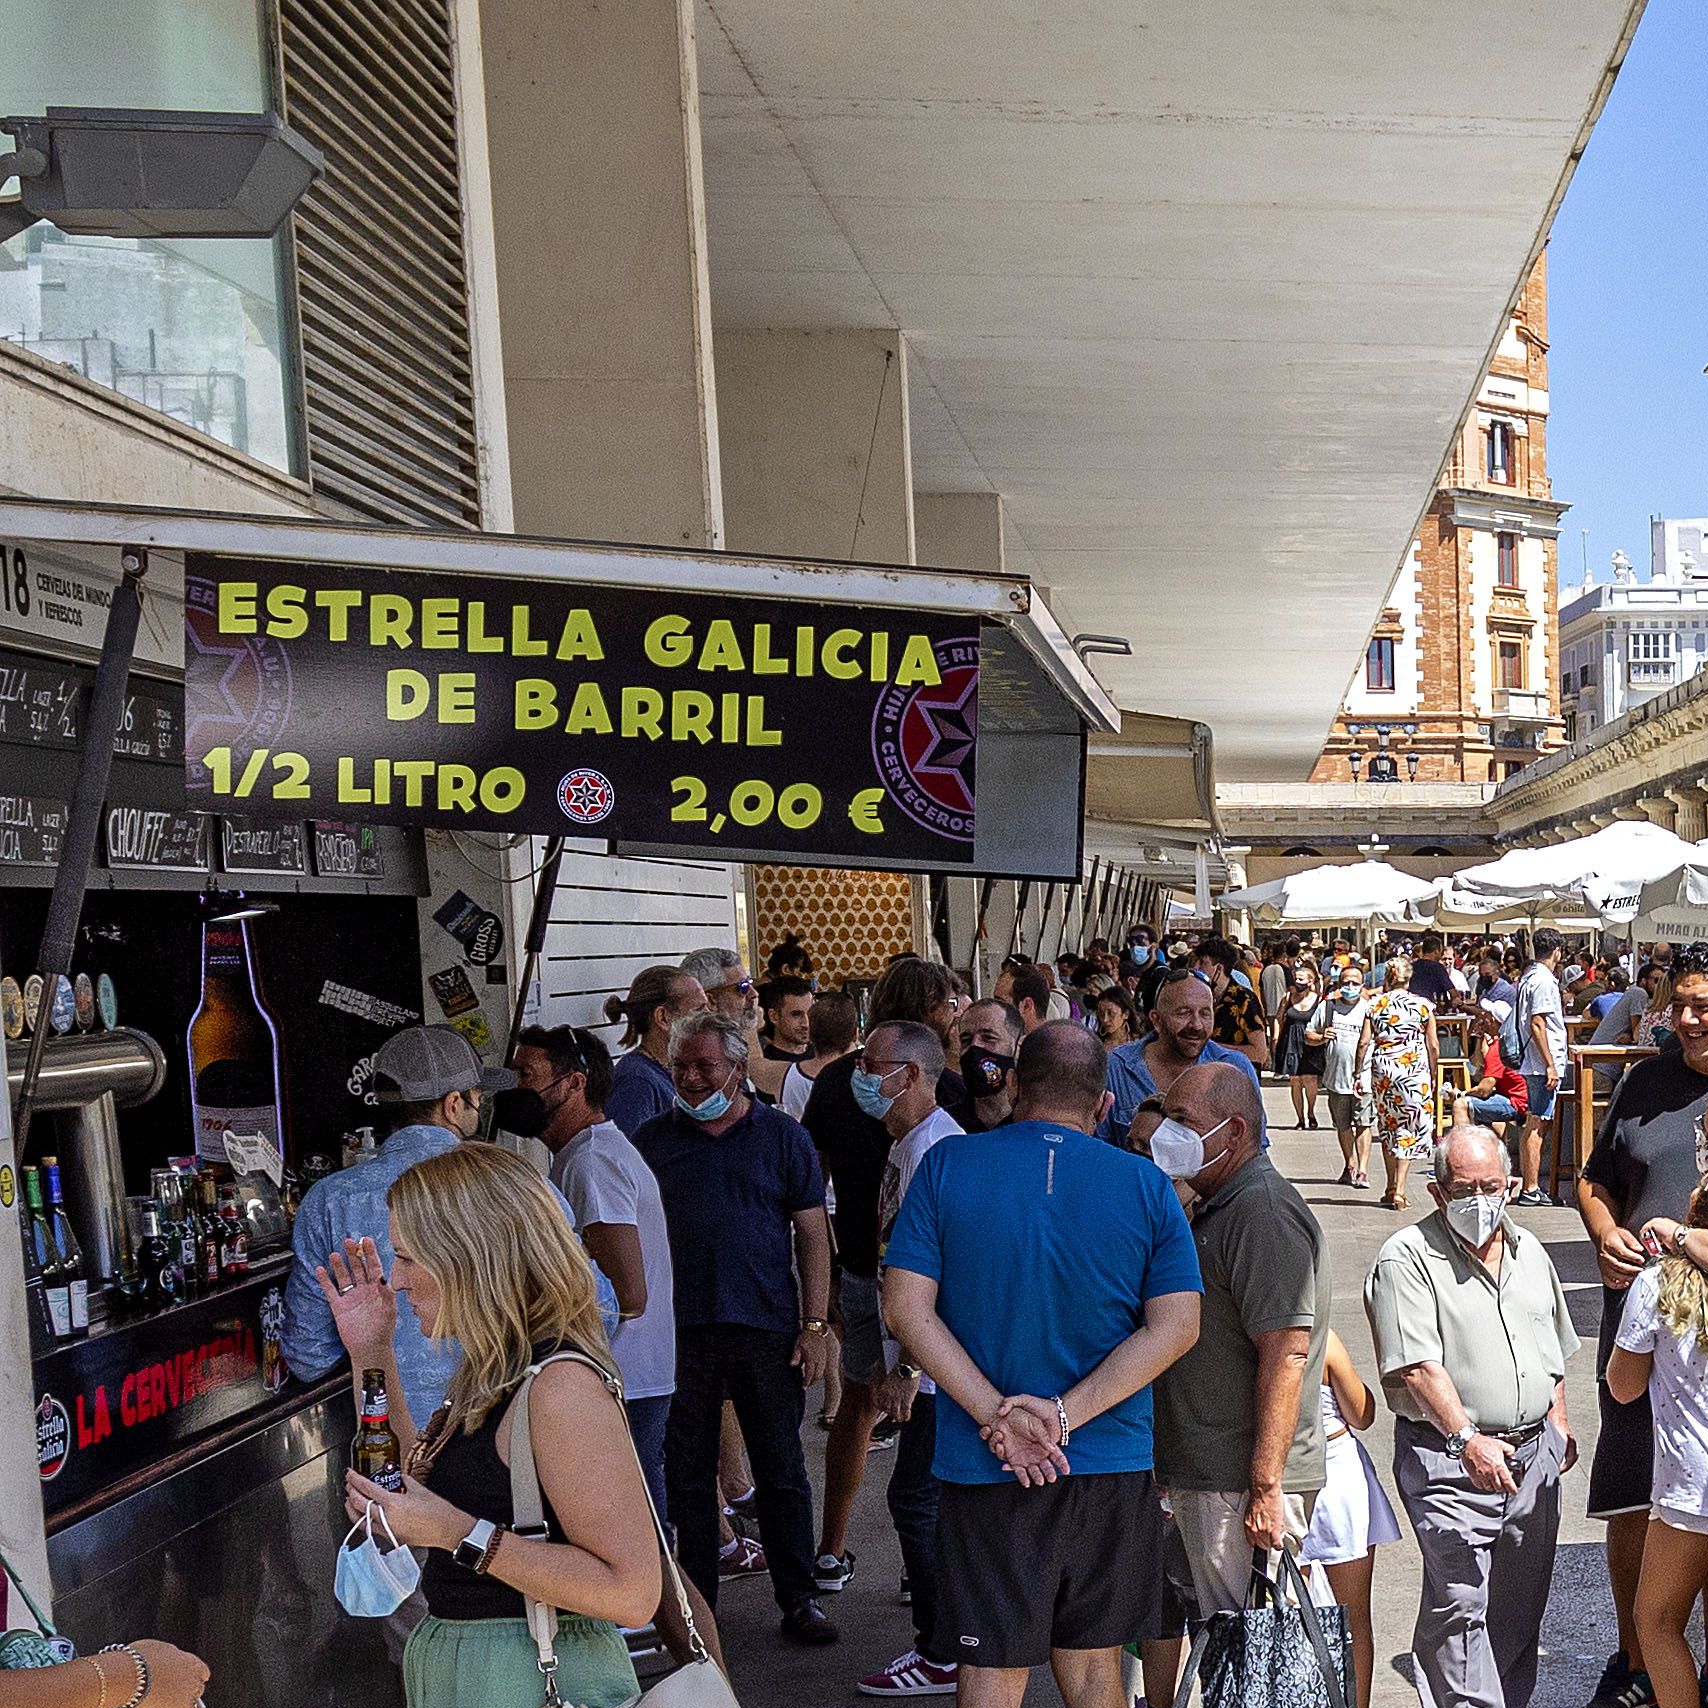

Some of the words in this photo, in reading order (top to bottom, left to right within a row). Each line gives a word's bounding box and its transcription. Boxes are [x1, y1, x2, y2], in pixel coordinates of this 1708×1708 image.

[36, 573, 71, 599] CERVEZAS
[72, 581, 85, 602] DEL
[85, 585, 111, 609] MUNDO
[37, 598, 44, 617] Y
[44, 602, 83, 627] REFRESCOS
[218, 582, 605, 661] ESTRELLA
[644, 614, 942, 686] GALICIA
[387, 669, 476, 724] DE
[515, 679, 783, 747] BARRIL
[202, 747, 311, 800] 1/2
[338, 757, 526, 814] LITRO
[670, 775, 823, 834] 2,00
[848, 788, 885, 834] €
[881, 741, 976, 834] CERVECEROS
[108, 808, 170, 864] CHOUFFE
[469, 918, 496, 962] GROSS
[75, 1385, 113, 1451] LA
